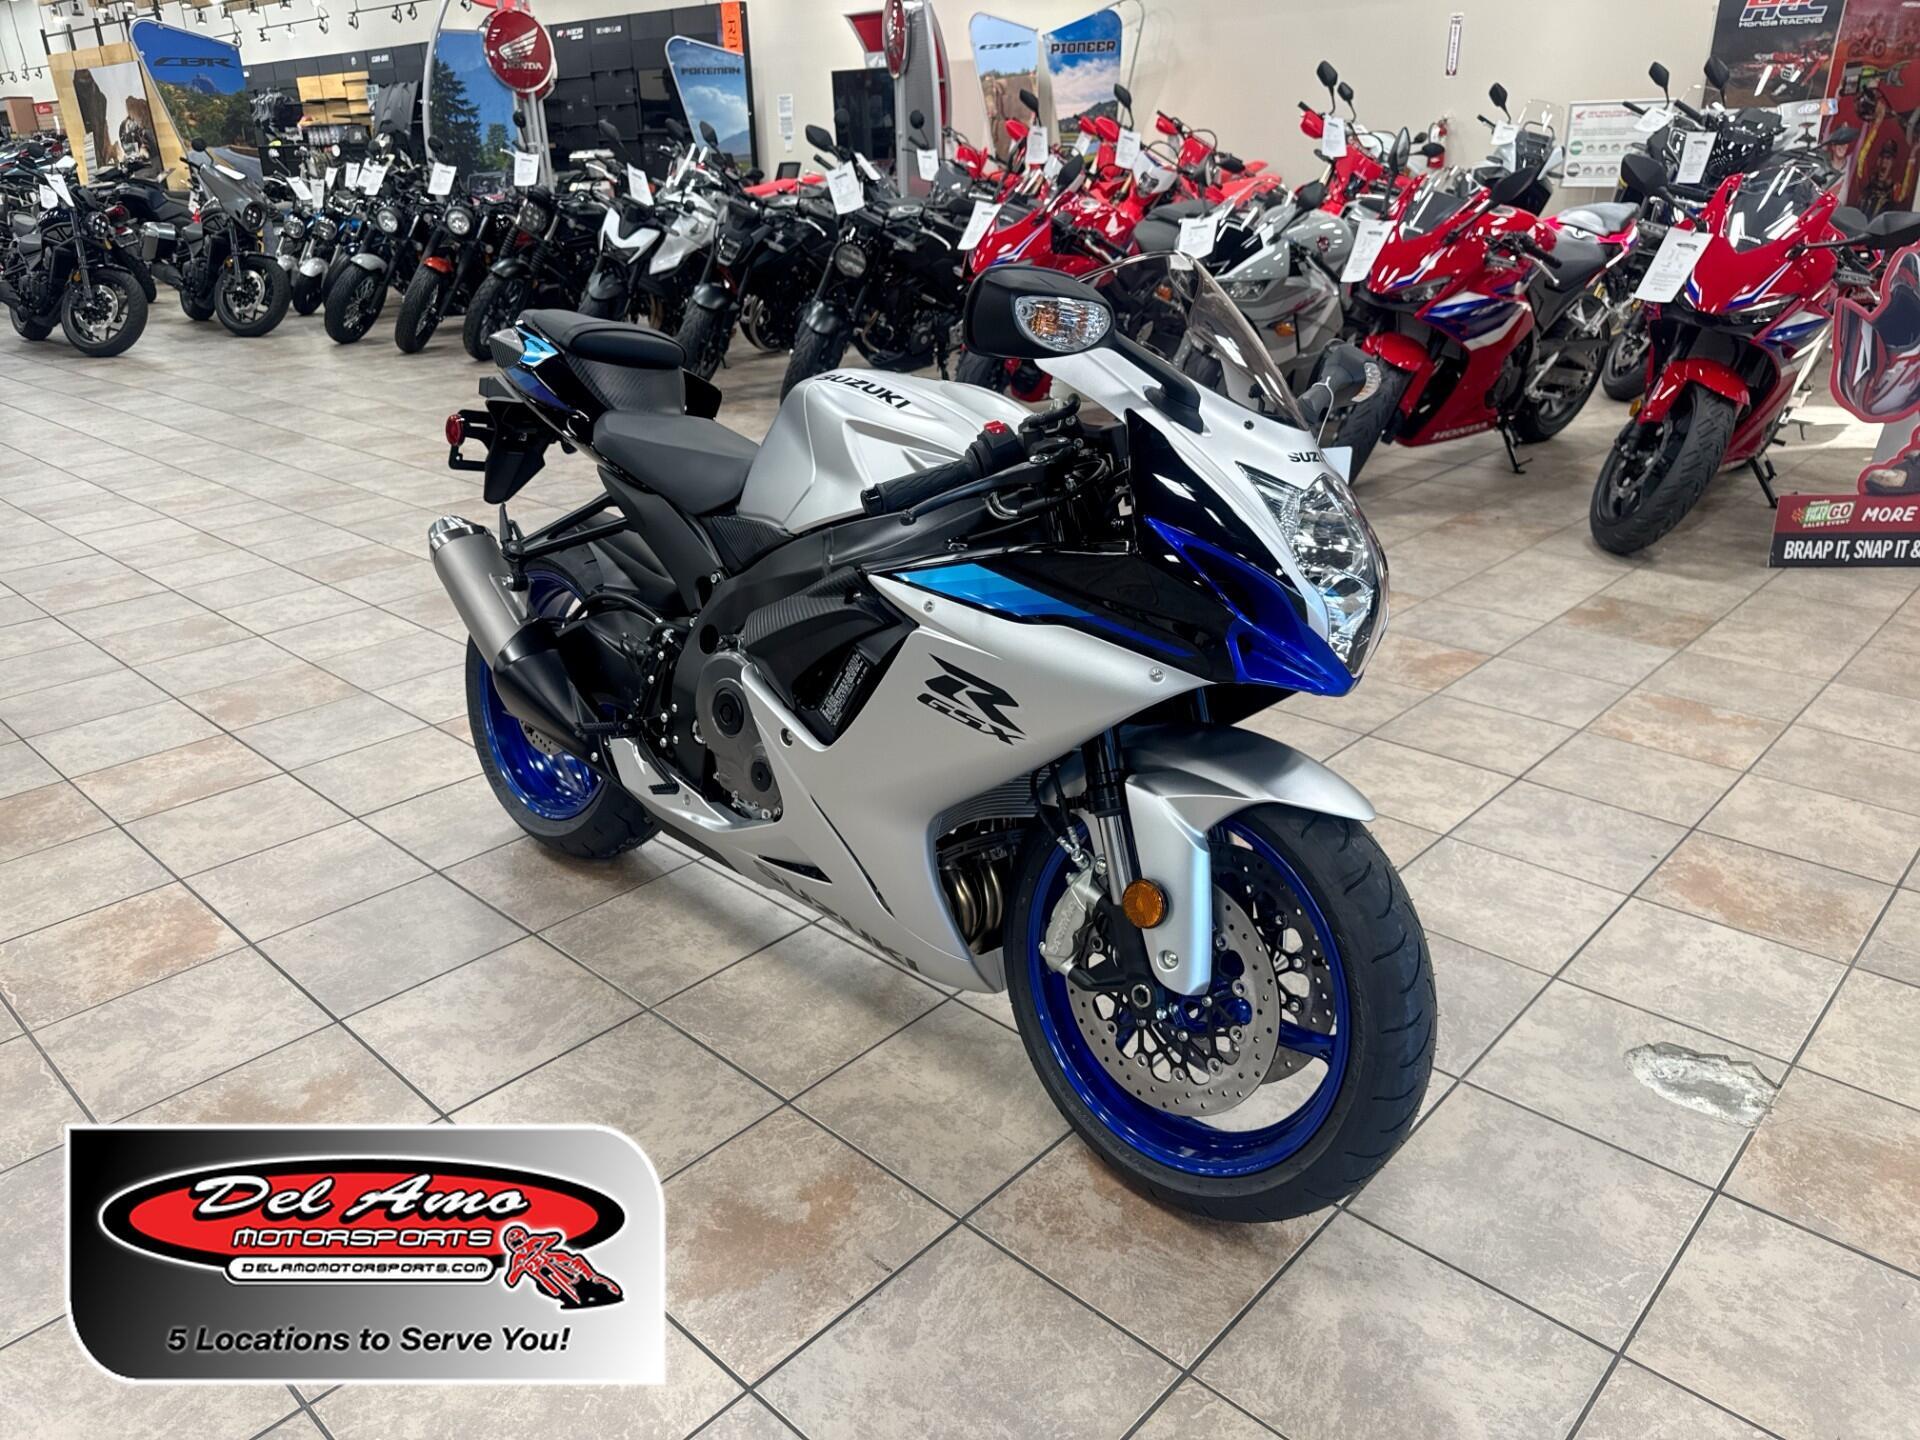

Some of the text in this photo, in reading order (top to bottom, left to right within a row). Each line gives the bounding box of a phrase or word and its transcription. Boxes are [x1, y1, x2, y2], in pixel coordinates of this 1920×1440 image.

[1739, 17, 1824, 28] Honda RACING
[1050, 40, 1117, 55] PIONEER
[153, 56, 238, 68] CBR
[502, 62, 543, 70] HONDA
[681, 66, 741, 76] FOREMAN
[815, 374, 912, 409] SUZUKI
[1287, 451, 1322, 463] SUZ
[1861, 506, 1918, 522] MORE
[1783, 540, 1834, 560] BRAAP
[1834, 540, 1851, 562] IT,
[1853, 539, 1893, 559] SNAP
[1894, 540, 1910, 558] IT
[924, 652, 1027, 736] R
